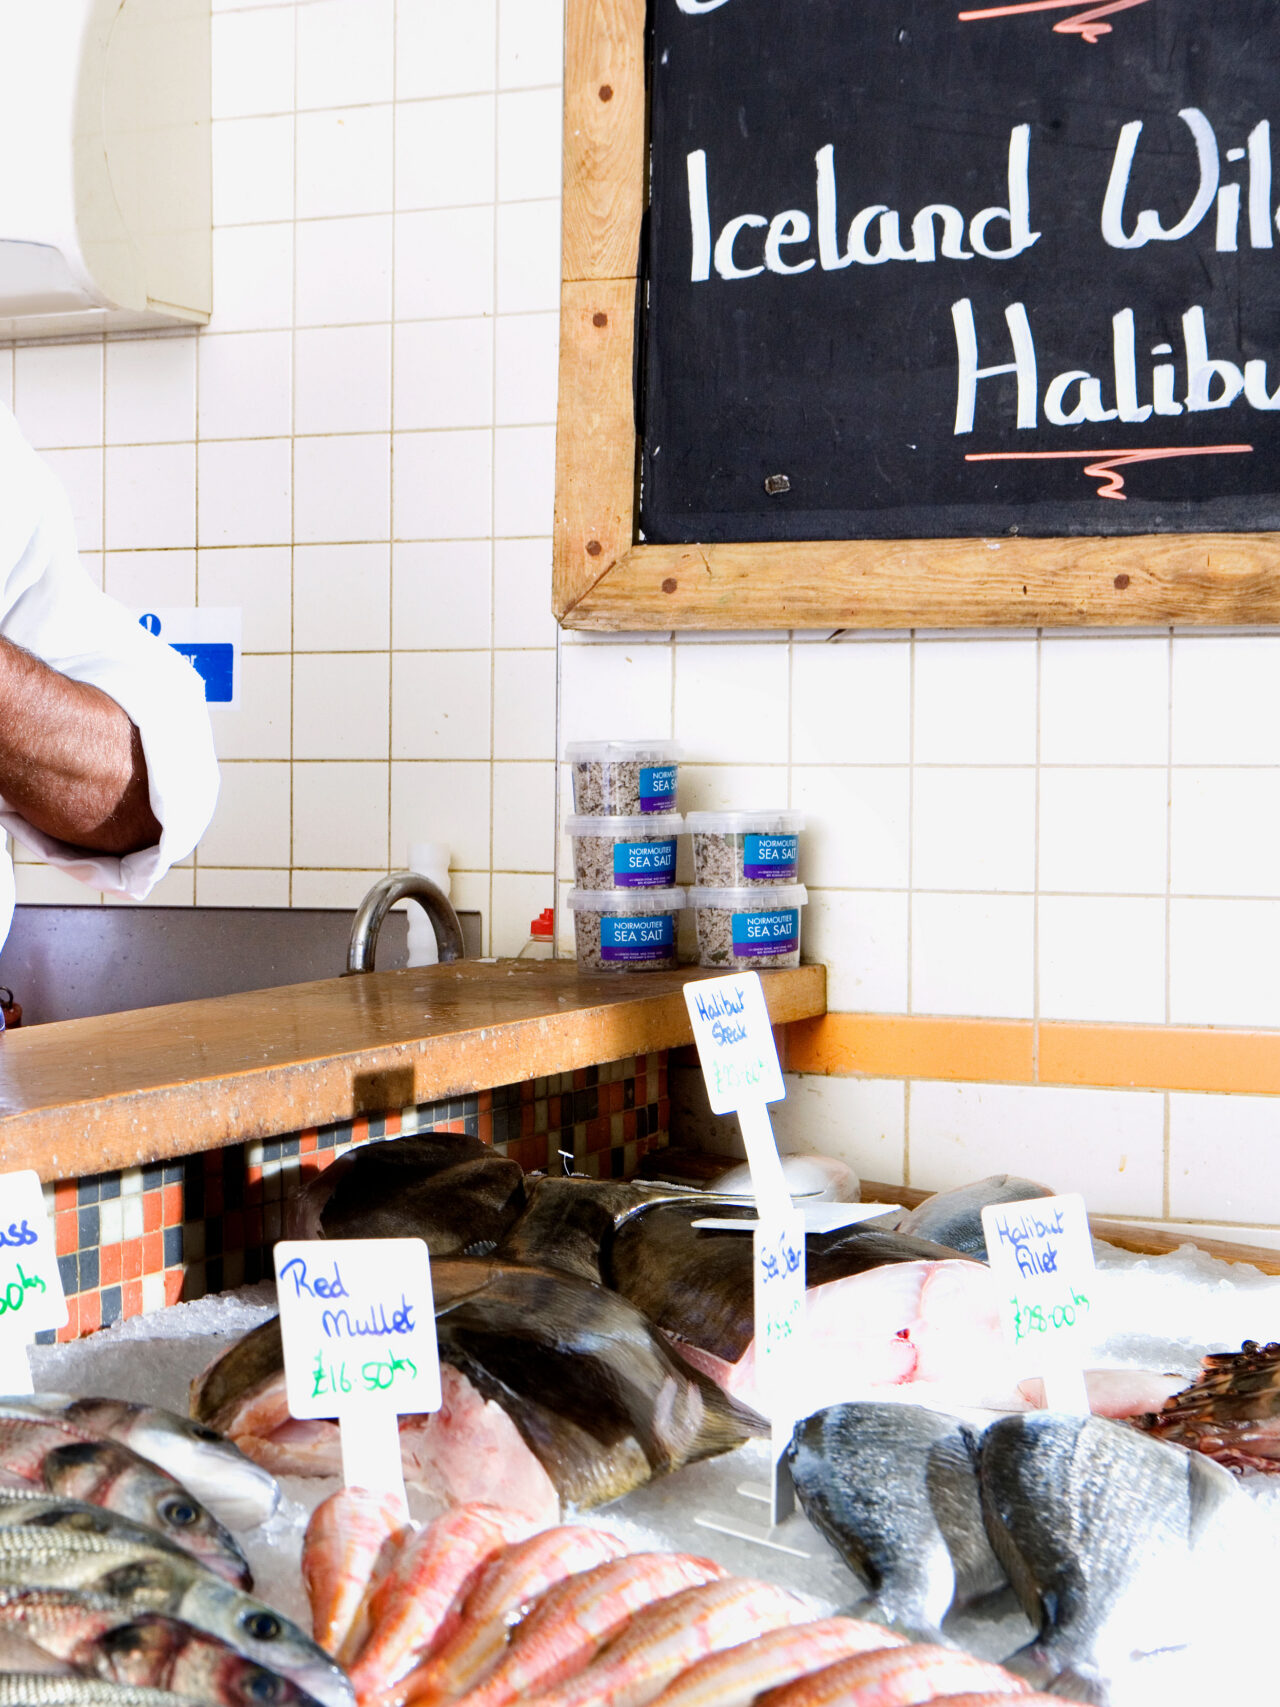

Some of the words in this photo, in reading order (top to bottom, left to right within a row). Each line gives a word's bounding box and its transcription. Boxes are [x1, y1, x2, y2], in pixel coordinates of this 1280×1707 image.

[687, 122, 1041, 282] Iceland
[1101, 107, 1280, 252] Wil
[652, 780, 670, 792] SEA
[628, 856, 651, 868] SEA
[653, 854, 672, 867] SALT
[758, 848, 780, 860] SEA
[781, 847, 797, 859] SALT
[614, 920, 663, 930] NOIRMOUTIER
[747, 914, 792, 926] NOIRMOUTIER
[614, 930, 637, 942] SEA
[640, 929, 663, 941] SALT
[747, 926, 770, 938] SEA
[773, 923, 793, 936] SALT
[694, 986, 745, 1022] Halibut
[711, 1019, 748, 1047] Steak
[995, 1207, 1064, 1246] Halibut
[279, 1258, 350, 1299] Red
[322, 1293, 415, 1338] Mullet
